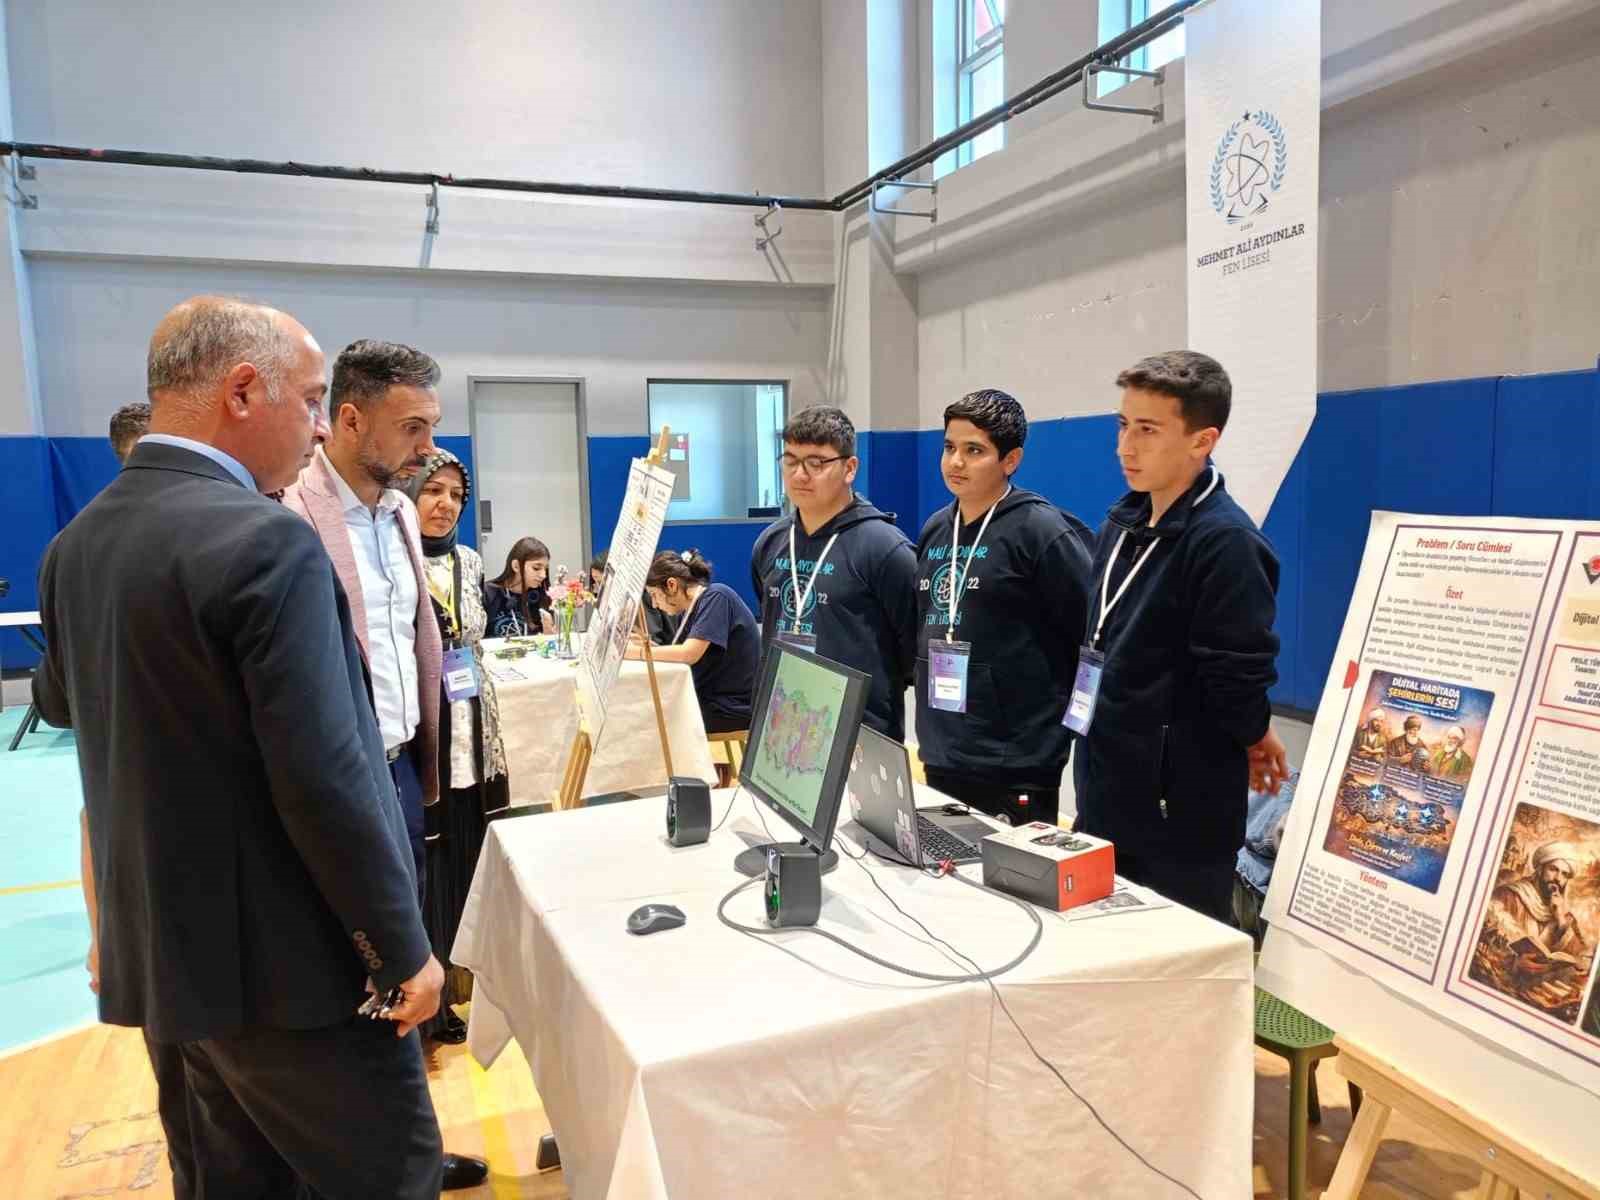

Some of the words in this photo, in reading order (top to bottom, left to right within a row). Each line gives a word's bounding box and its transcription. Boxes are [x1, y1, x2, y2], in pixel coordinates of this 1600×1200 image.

[1197, 246, 1236, 268] MEHMET
[1236, 238, 1252, 256] ALİ
[1252, 223, 1305, 249] AYDINLAR
[1222, 259, 1241, 276] FEN
[1416, 537, 1448, 550] Problem
[1455, 540, 1475, 551] Soru
[1476, 542, 1513, 554] Cümlesi
[919, 579, 930, 591] 20
[967, 577, 980, 590] 22
[769, 586, 780, 598] 20
[817, 592, 829, 605] 22
[1445, 586, 1464, 600] Özet
